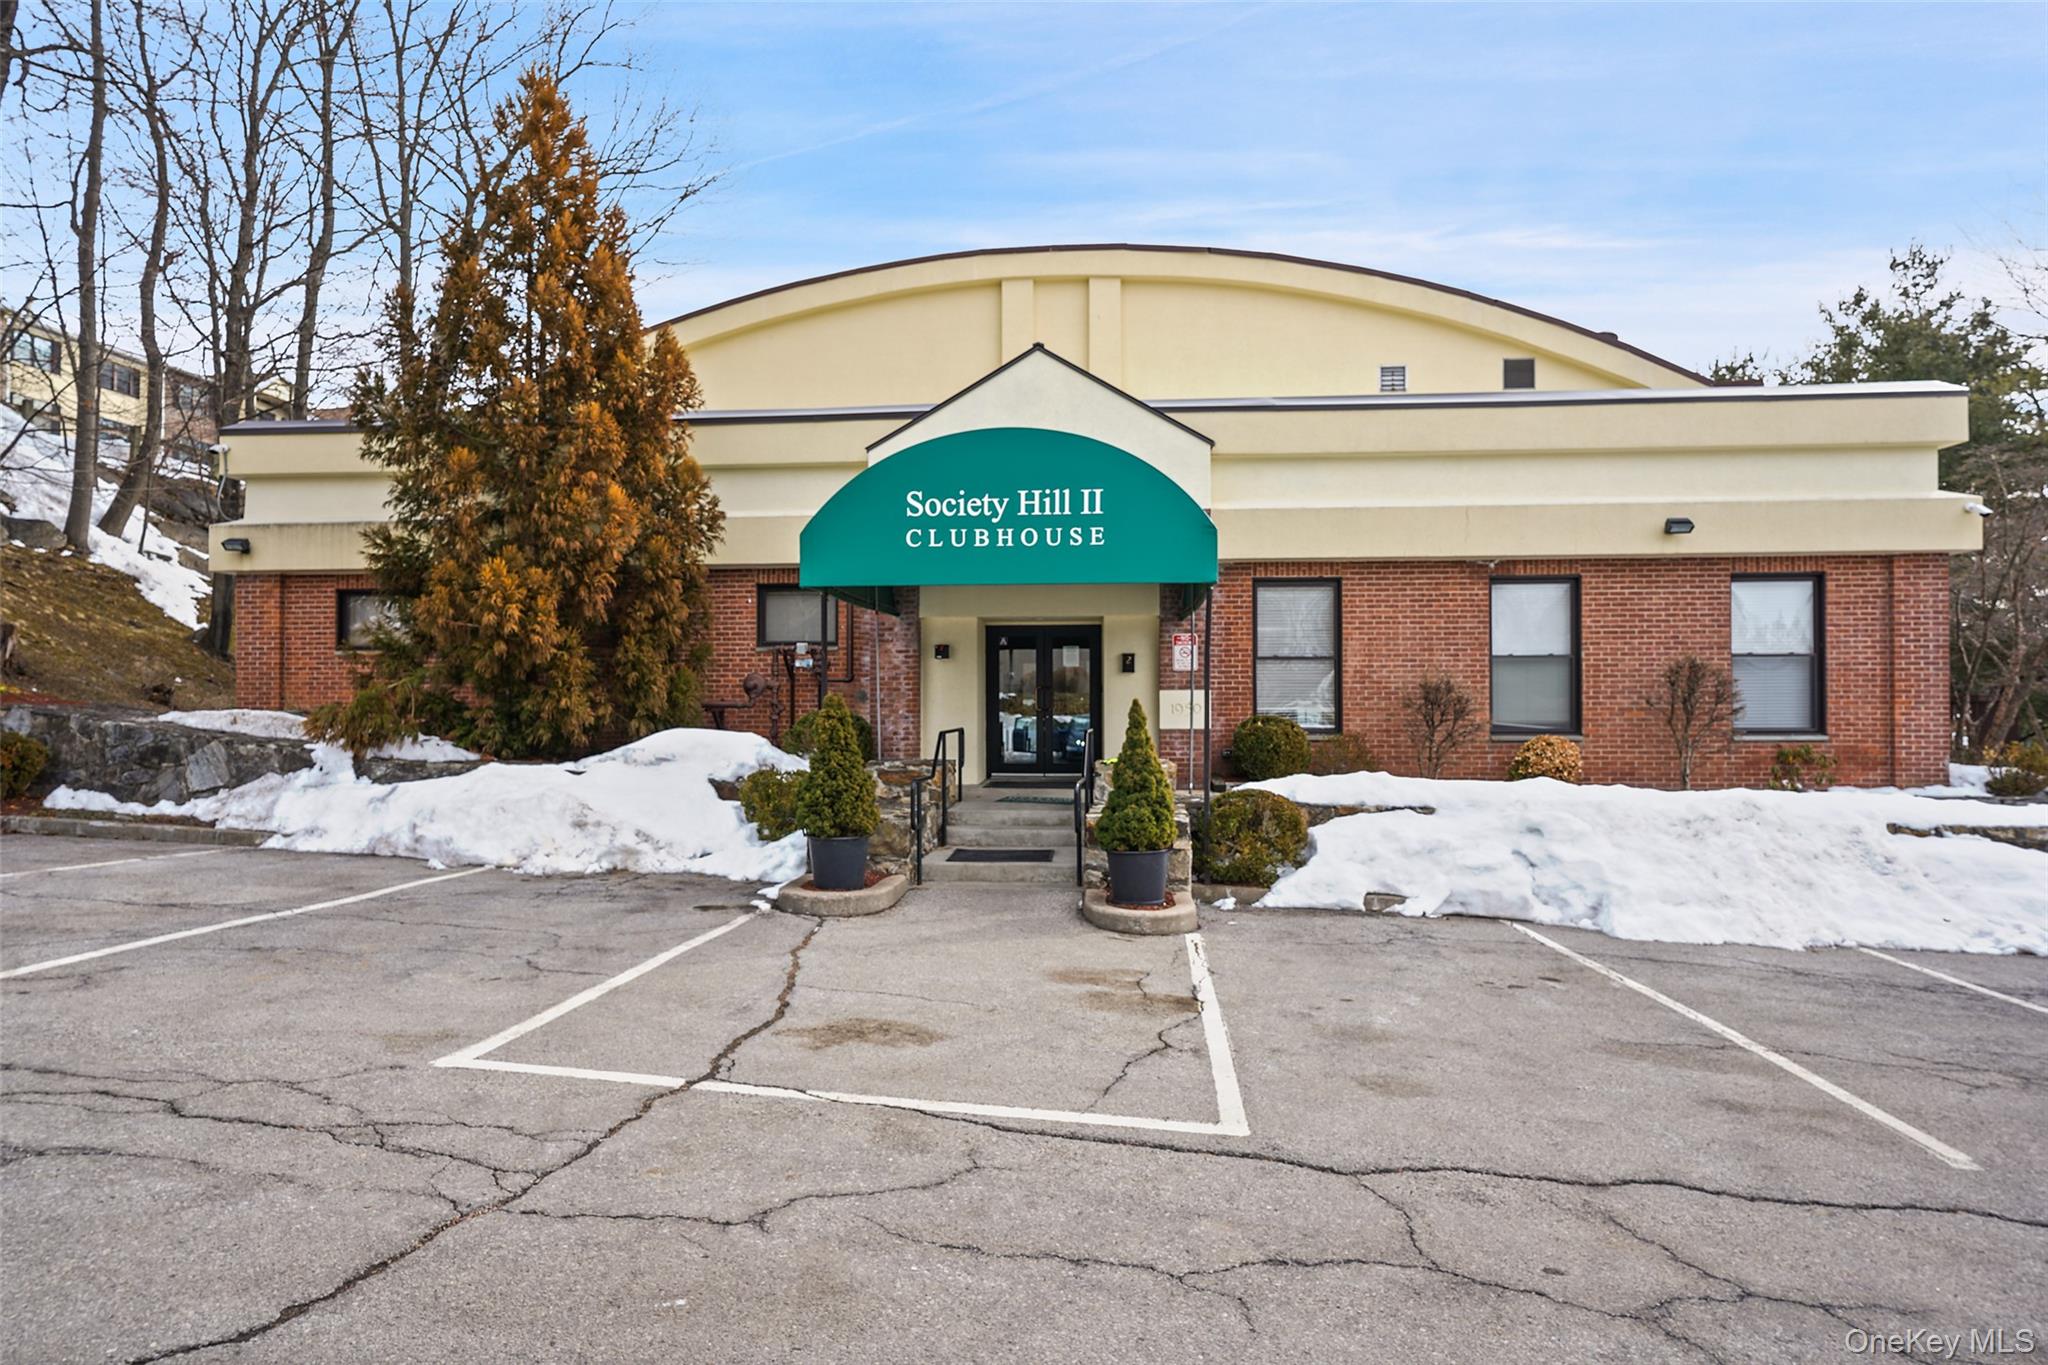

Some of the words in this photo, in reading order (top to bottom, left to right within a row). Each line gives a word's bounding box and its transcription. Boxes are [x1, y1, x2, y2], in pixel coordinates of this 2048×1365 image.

[905, 489, 1009, 524] Society
[1017, 488, 1071, 516] Hill
[1080, 488, 1104, 515] II
[905, 526, 1105, 548] CLUBHOUSE
